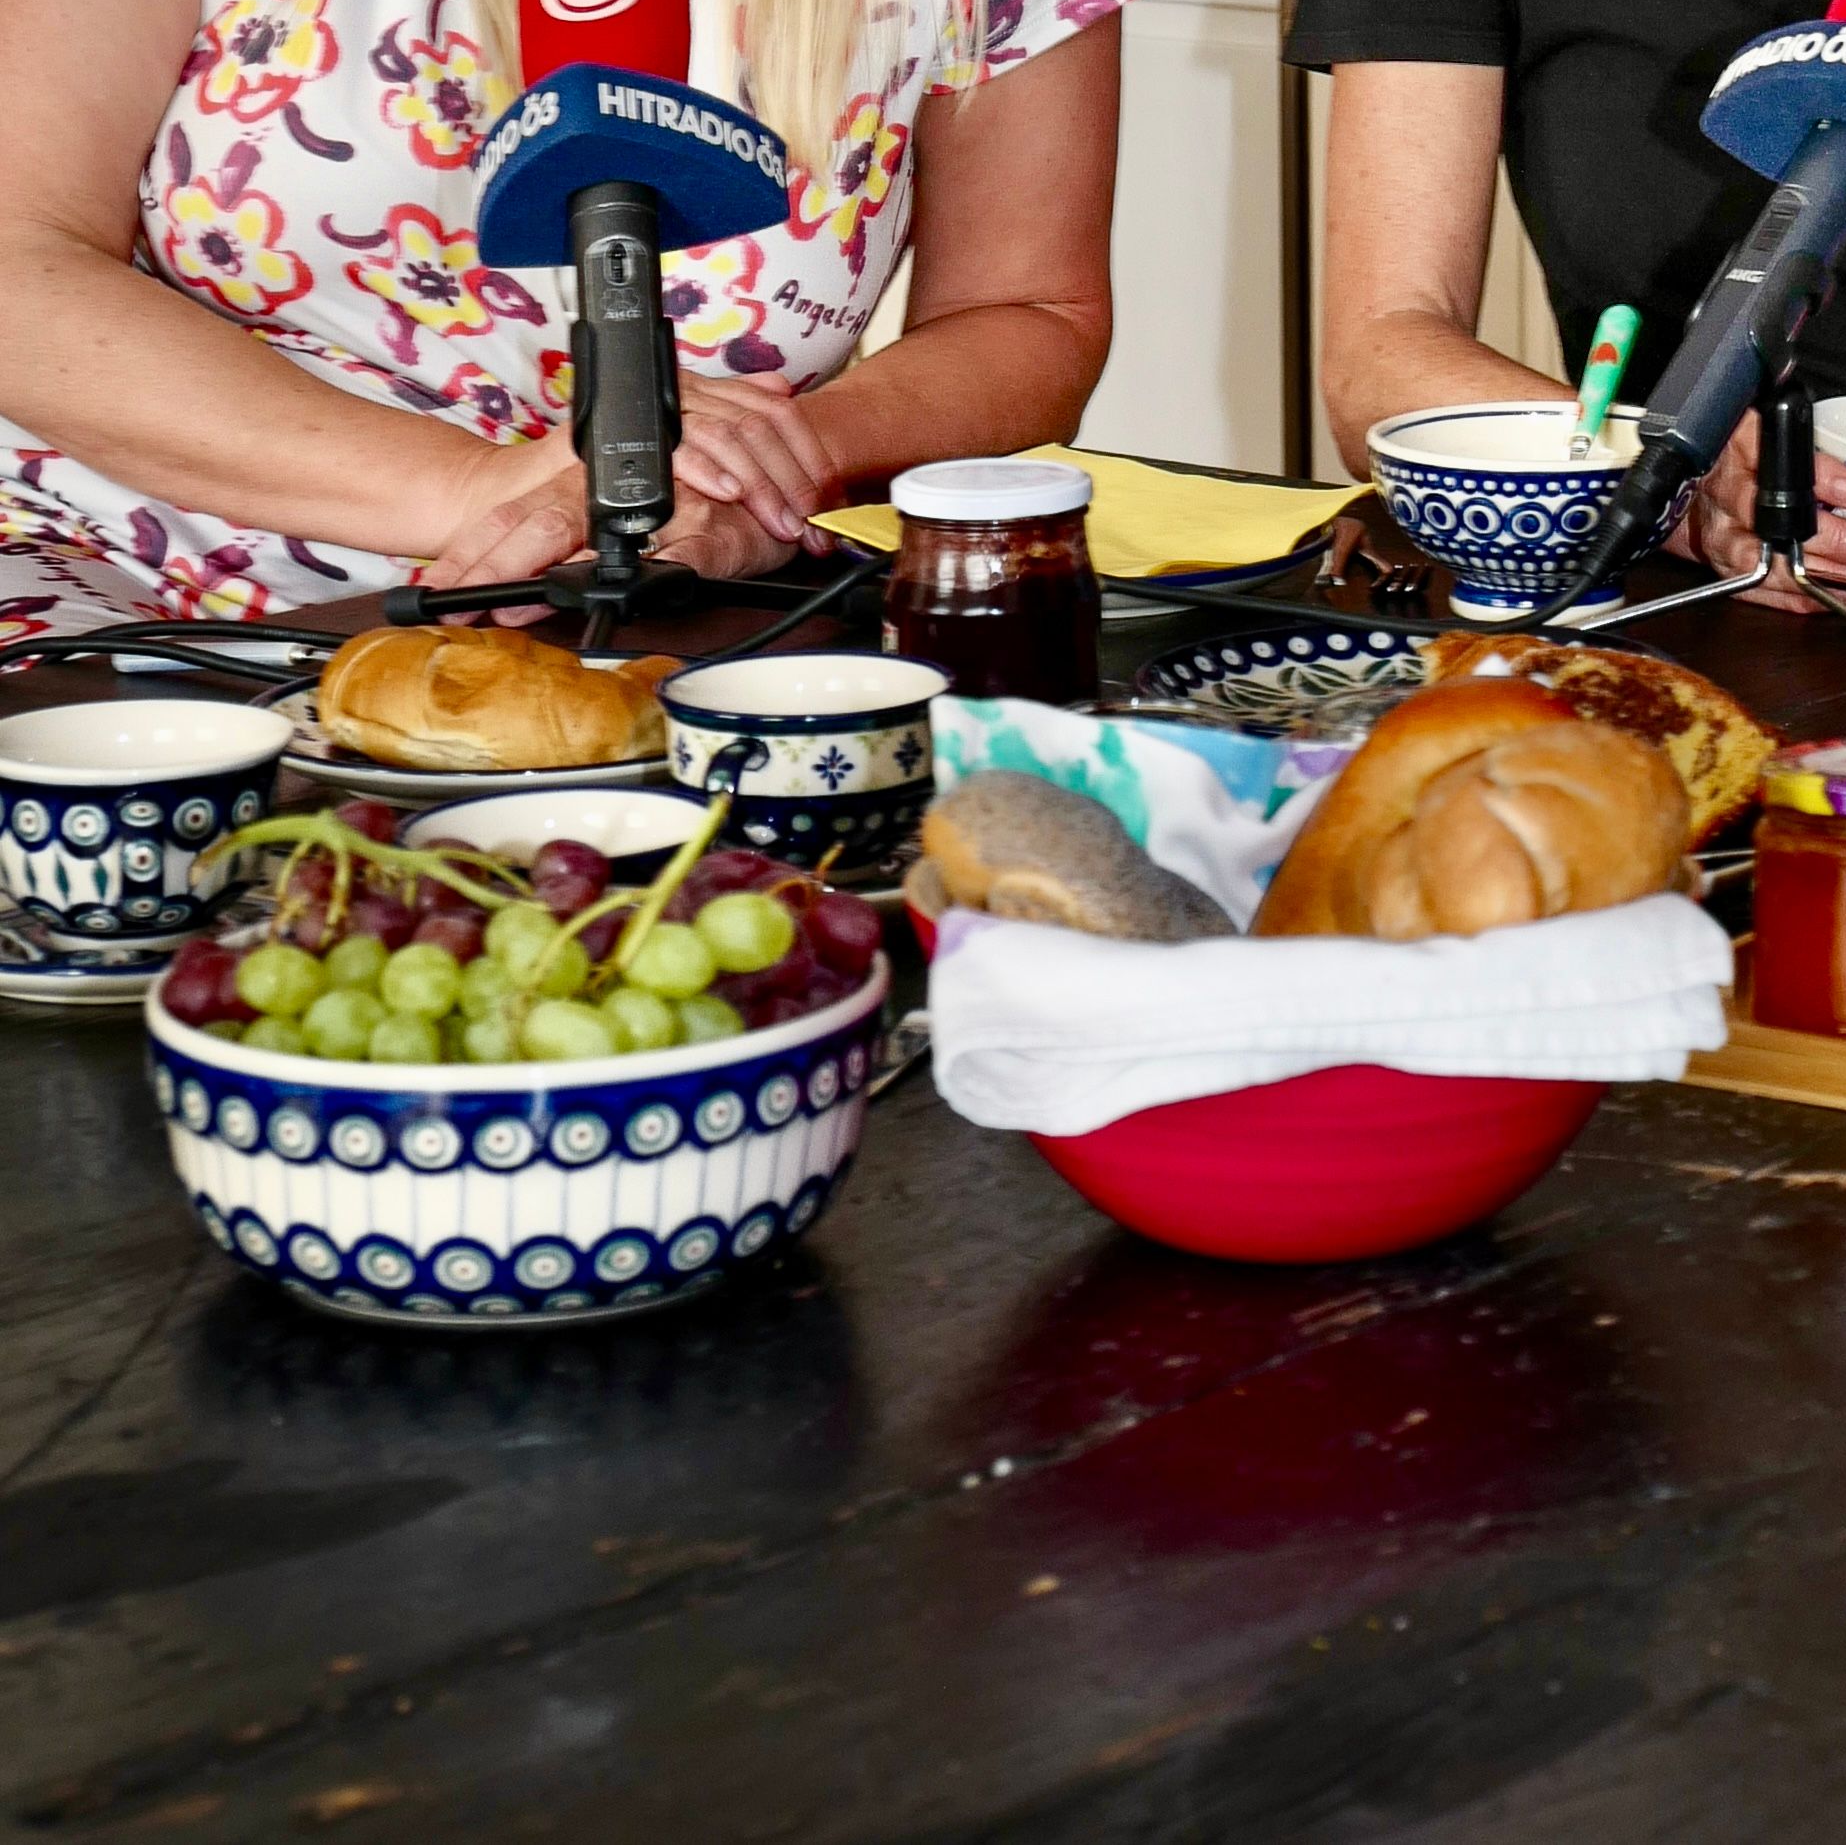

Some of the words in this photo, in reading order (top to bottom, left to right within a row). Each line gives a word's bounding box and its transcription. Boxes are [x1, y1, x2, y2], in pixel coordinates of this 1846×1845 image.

[520, 91, 561, 137] Ö3
[598, 83, 755, 163] HITRADIO
[755, 135, 786, 189] Ö3
